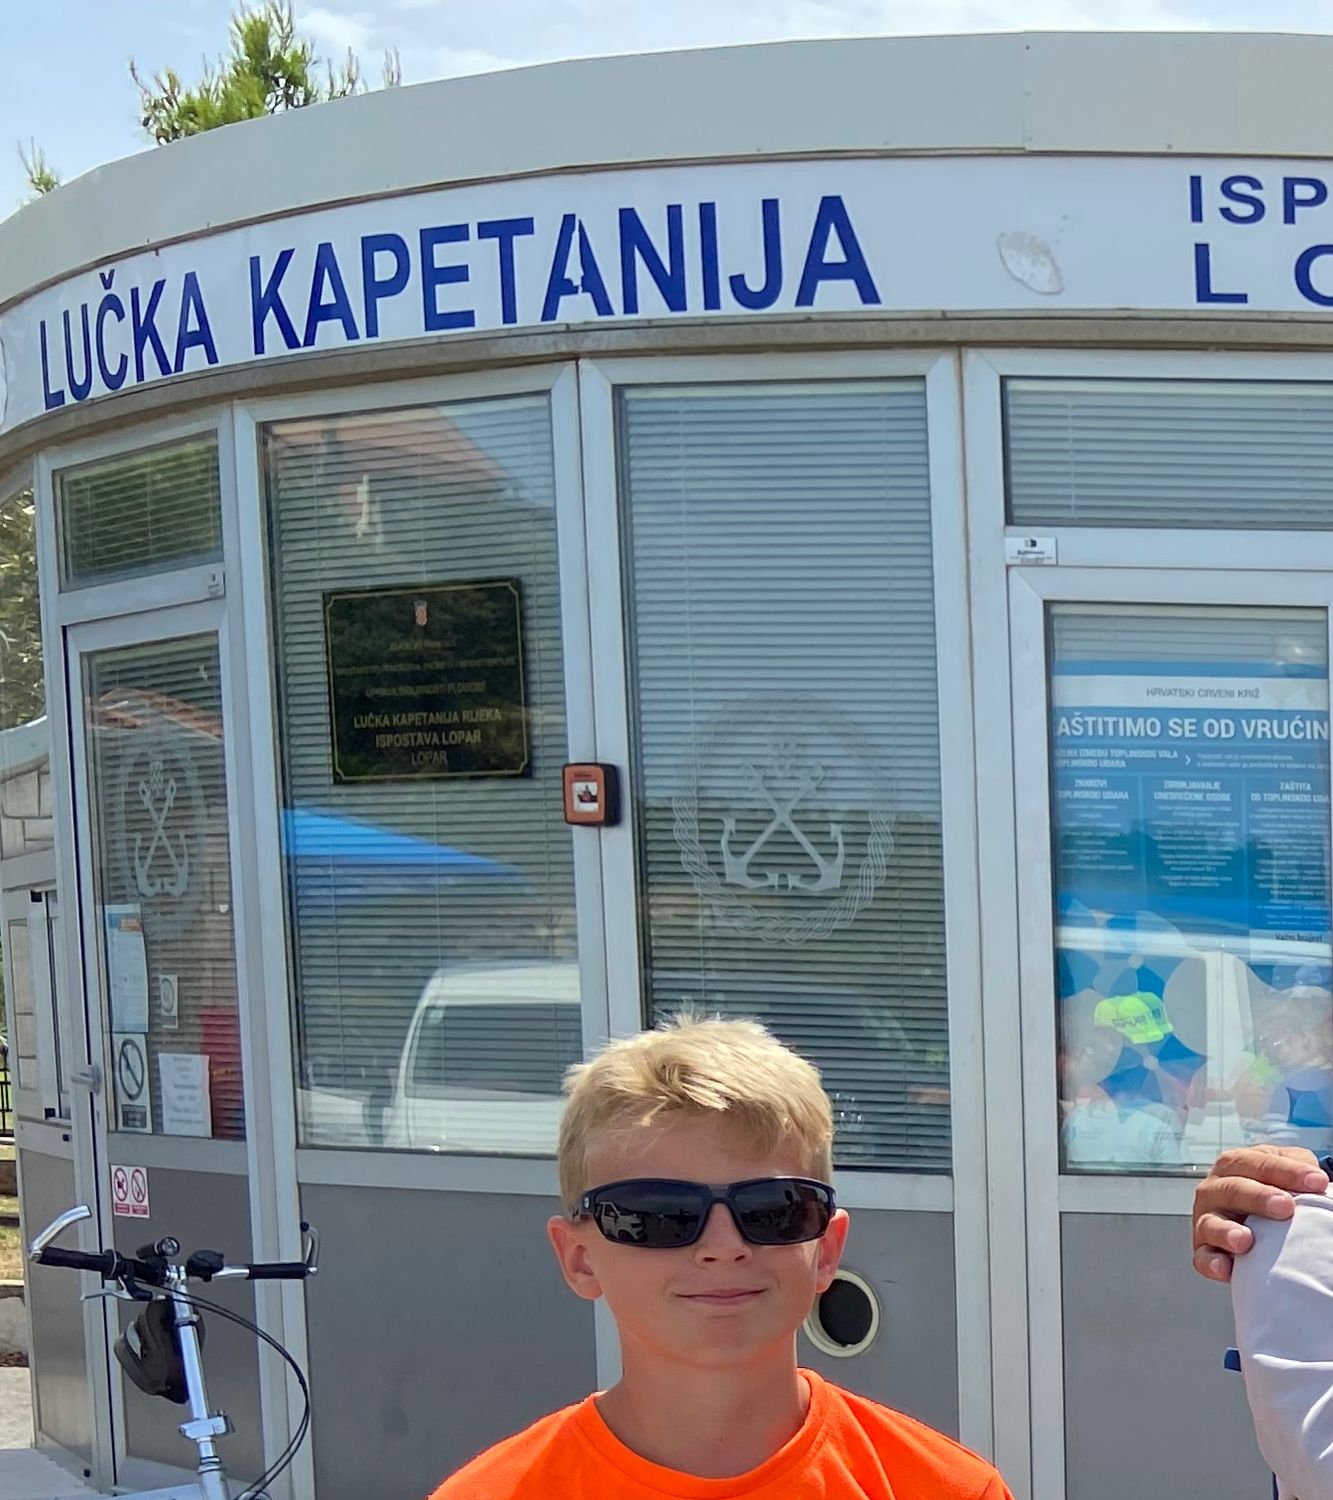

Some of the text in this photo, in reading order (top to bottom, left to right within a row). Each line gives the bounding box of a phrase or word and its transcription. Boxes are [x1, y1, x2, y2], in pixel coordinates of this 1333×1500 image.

[39, 194, 884, 411] LUČKA KAPETANIJA
[1146, 687, 1261, 699] HRVATSKI CRVENI KRIŽ
[353, 708, 503, 729] LUČKA KAPETANIJA RIJEKA
[1168, 717, 1198, 739] SE
[1203, 718, 1235, 740] OD
[1241, 714, 1329, 740] VRUĆIN
[375, 729, 482, 748] ISPOSTAVA LOPAR
[411, 750, 449, 766] LOPAR
